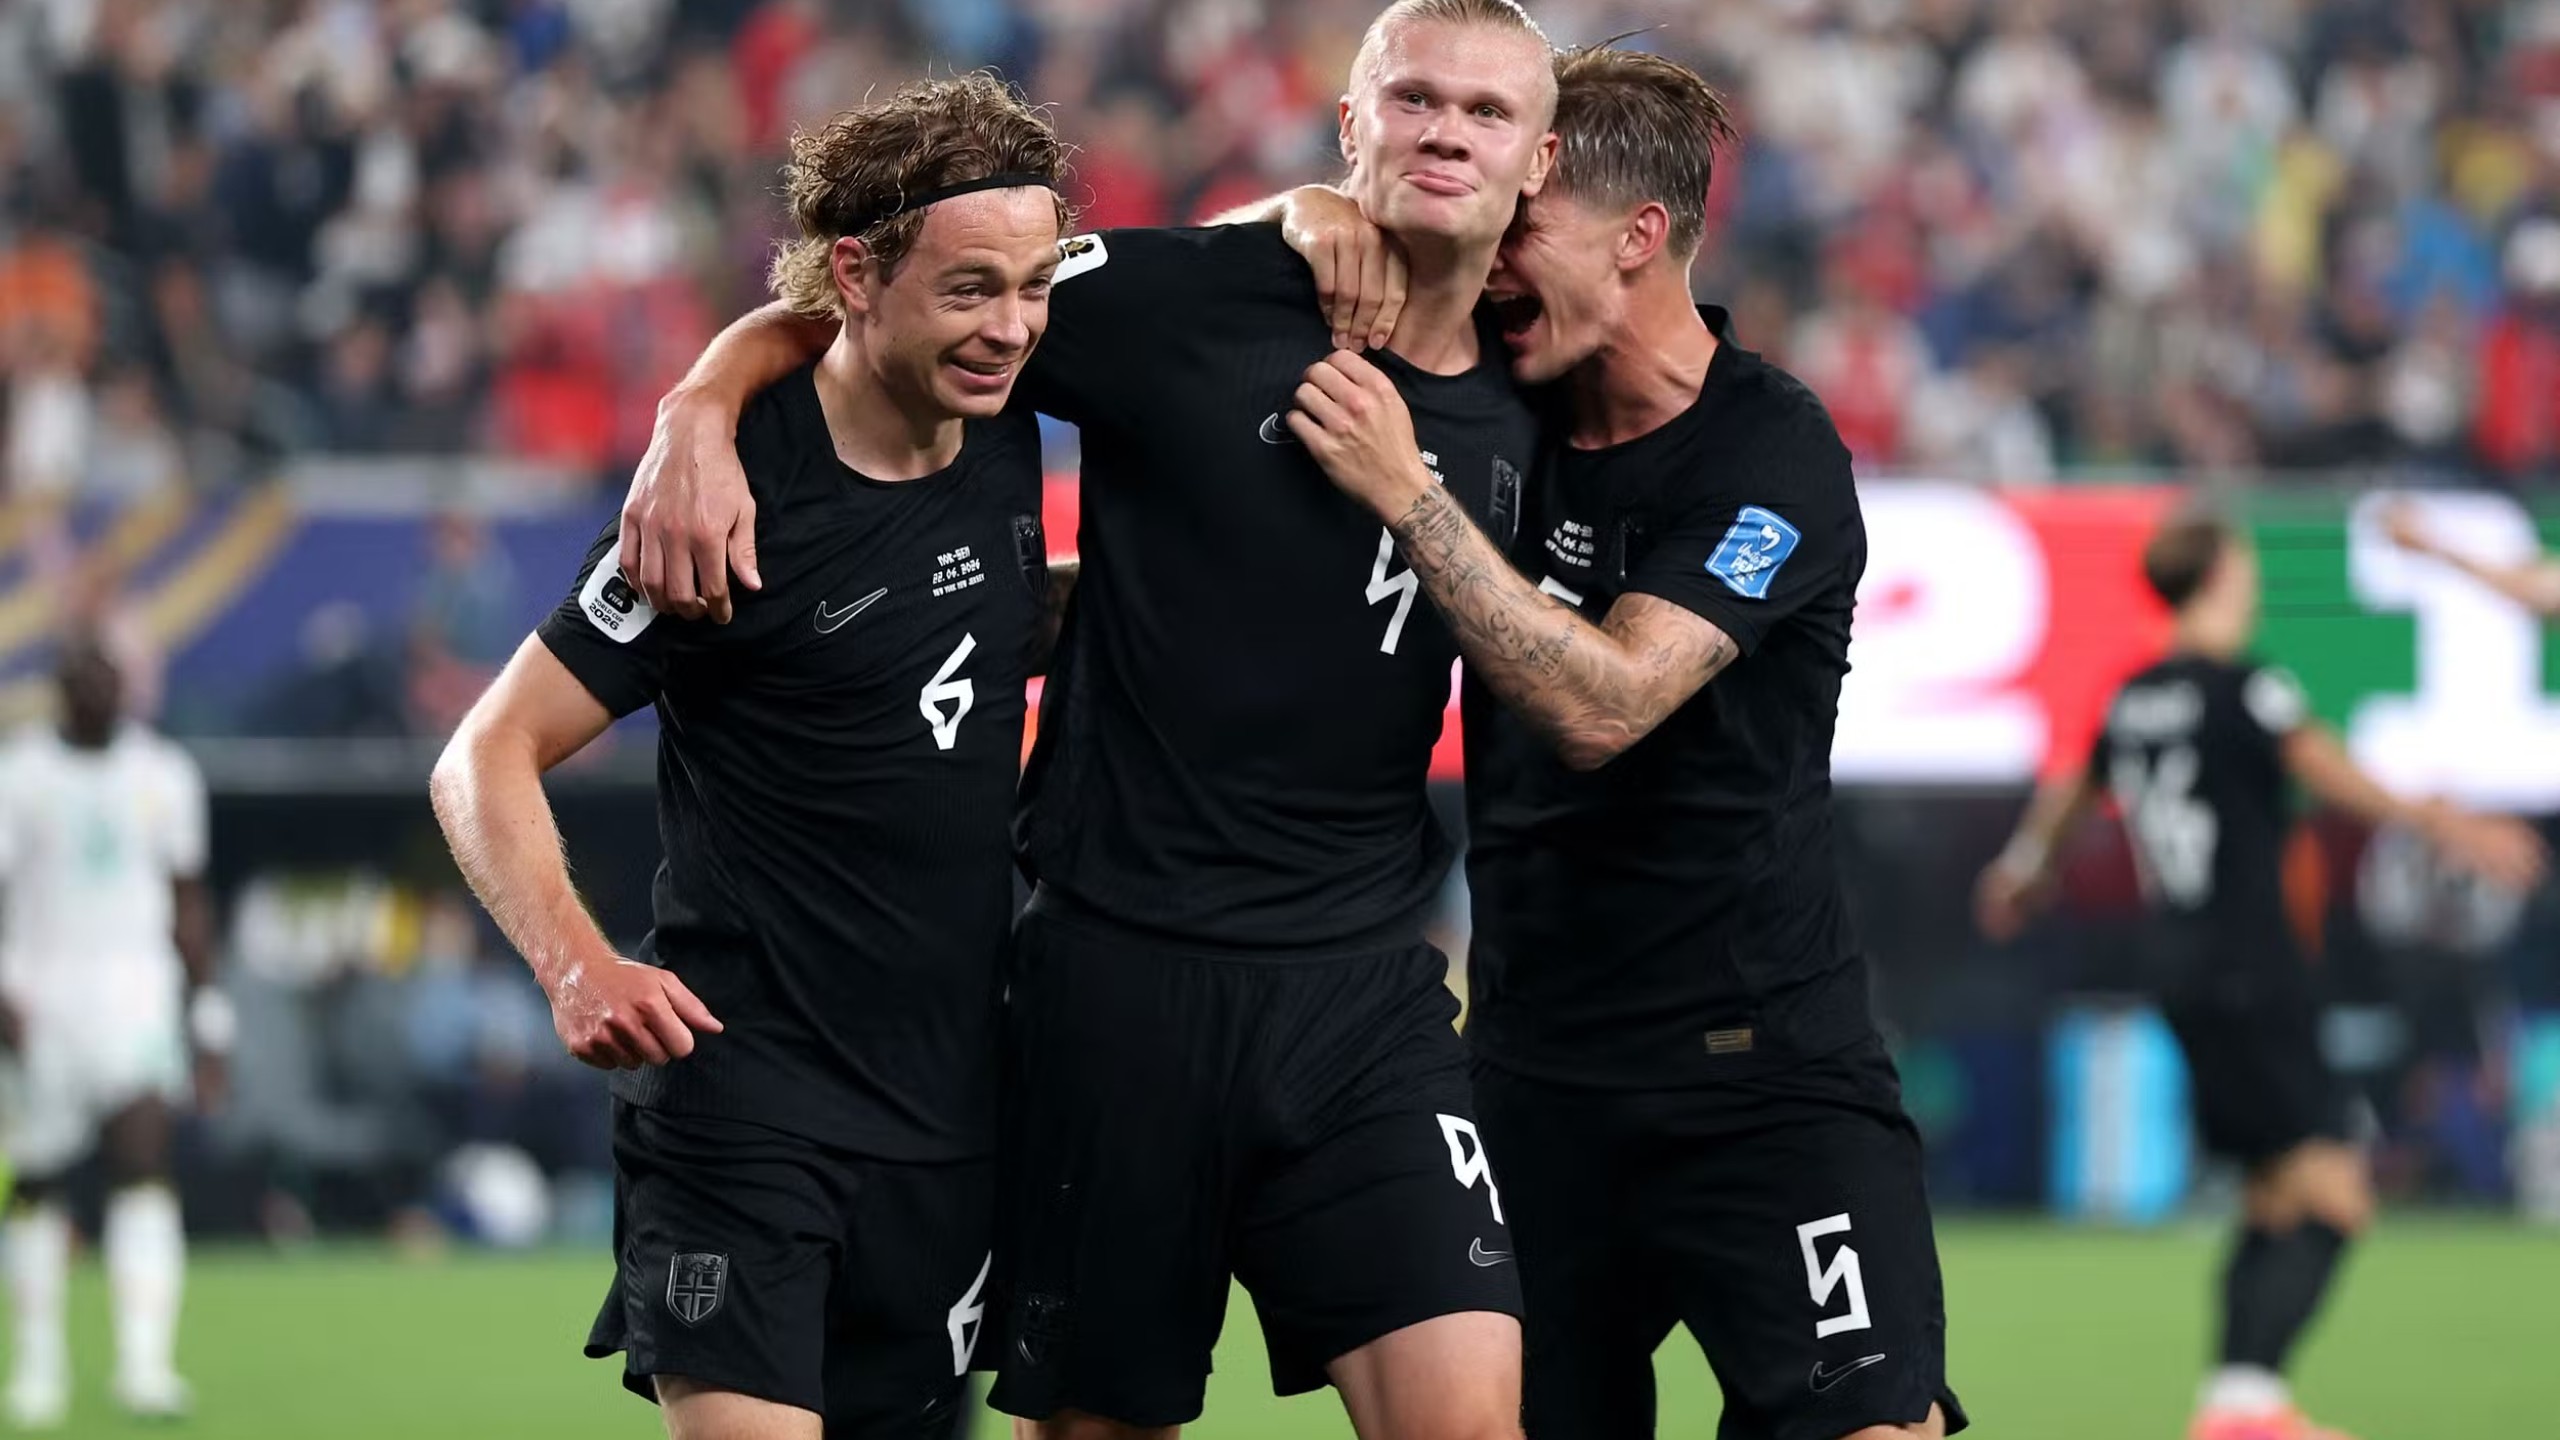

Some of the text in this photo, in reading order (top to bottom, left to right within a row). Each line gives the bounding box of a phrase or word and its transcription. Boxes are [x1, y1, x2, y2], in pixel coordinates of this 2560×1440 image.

[588, 602, 620, 631] 2026
[594, 596, 625, 623] WORLD CUP
[607, 592, 625, 608] FIFA
[1829, 482, 2052, 785] 2
[2347, 490, 2560, 813] 1
[919, 632, 976, 751] 6
[1436, 1113, 1505, 1226] 9
[946, 1248, 992, 1377] 6
[1796, 1212, 1872, 1340] 5
